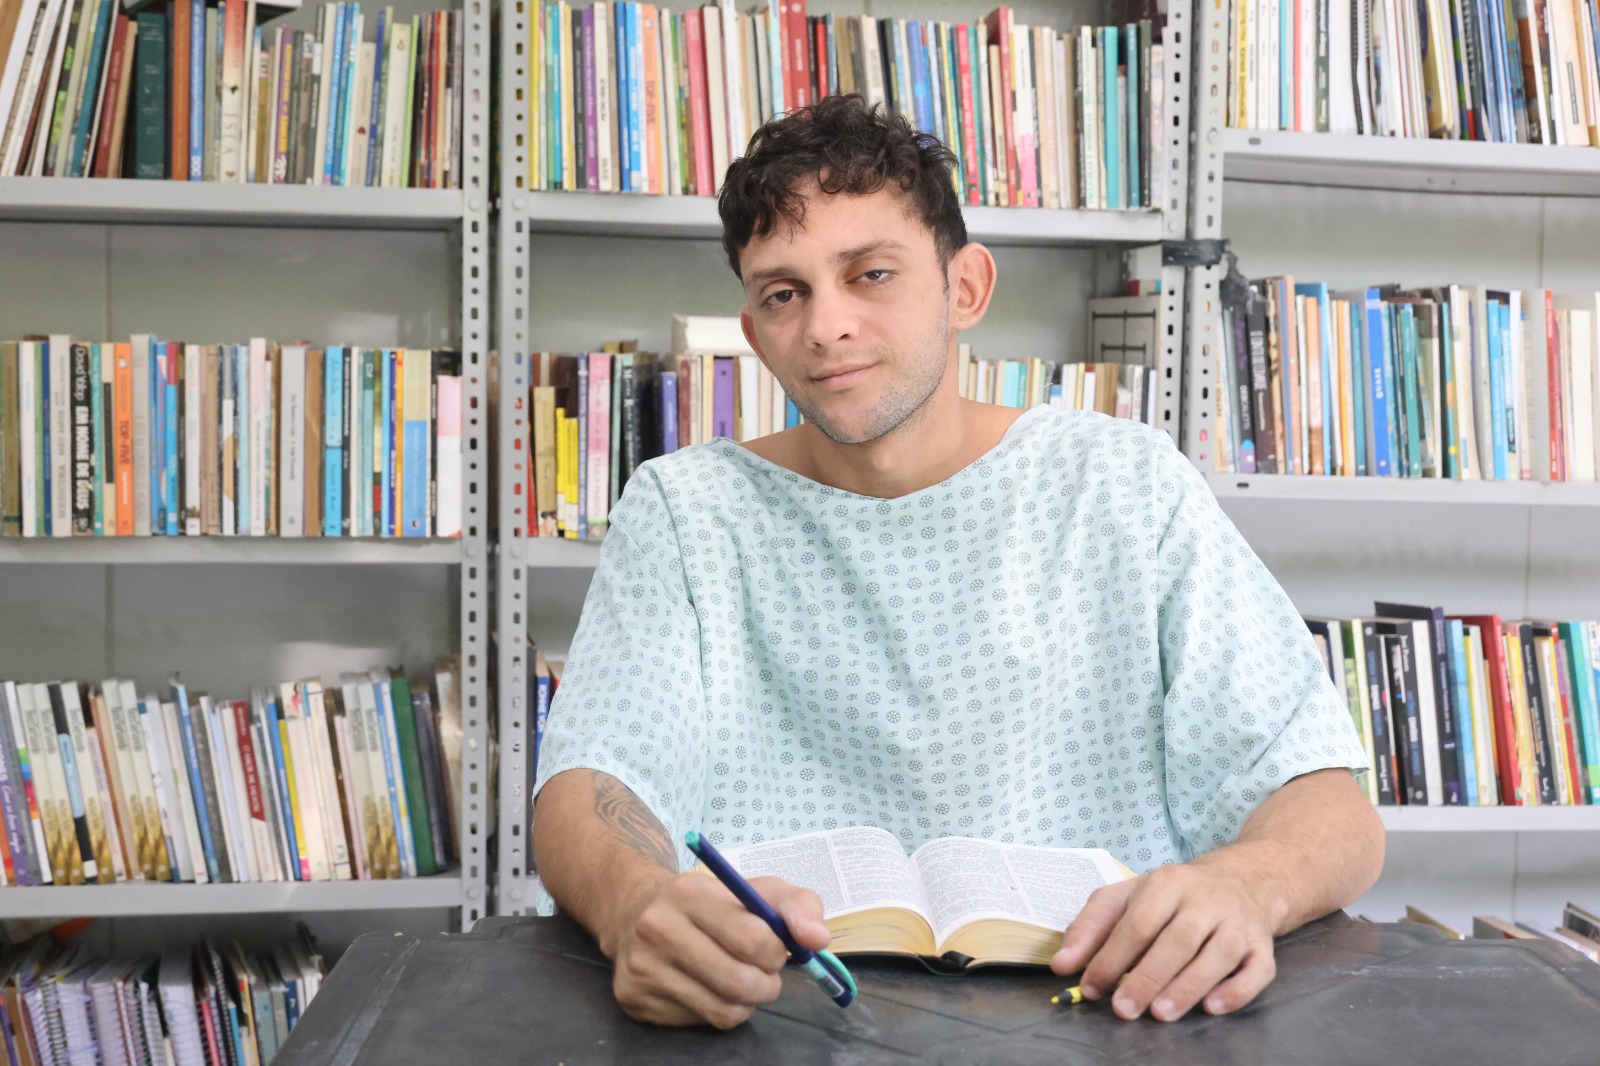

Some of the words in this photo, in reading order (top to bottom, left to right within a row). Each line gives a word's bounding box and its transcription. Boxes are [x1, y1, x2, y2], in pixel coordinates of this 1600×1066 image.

[74, 347, 86, 375] David
[73, 375, 86, 401] Yallop
[75, 406, 88, 424] EM
[76, 425, 88, 460] NOME
[76, 462, 88, 478] DE
[76, 479, 89, 510] DEUS
